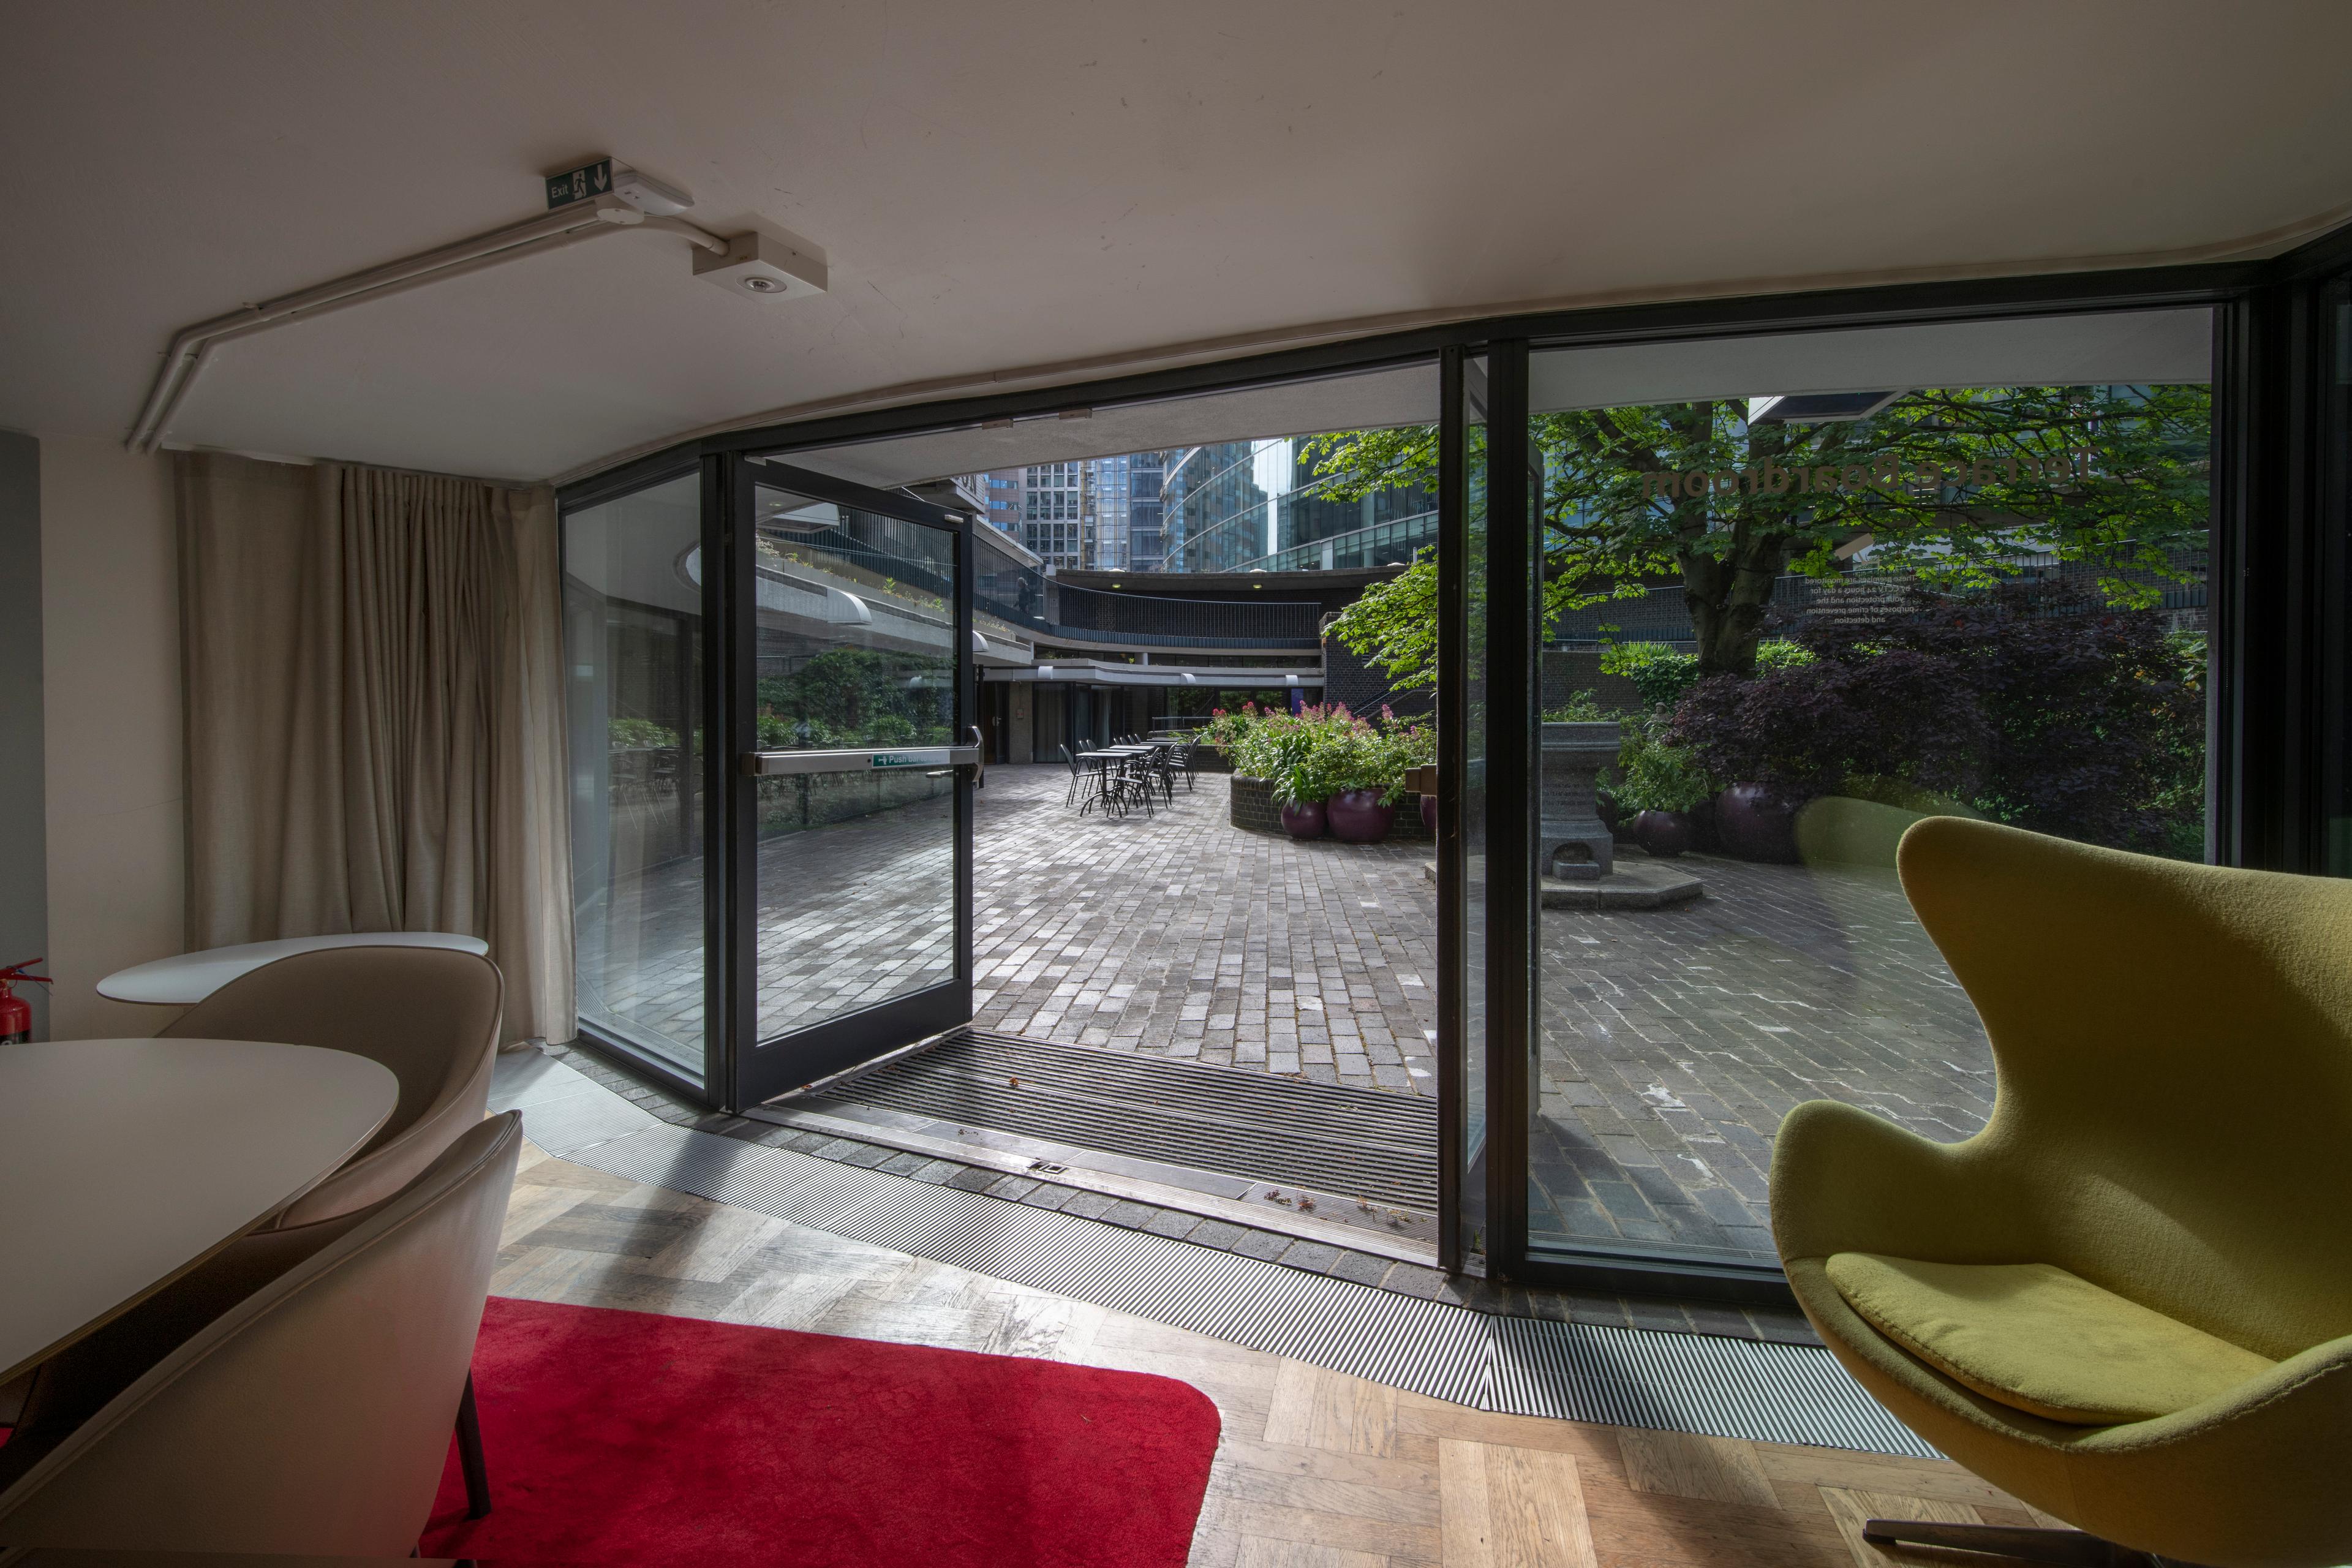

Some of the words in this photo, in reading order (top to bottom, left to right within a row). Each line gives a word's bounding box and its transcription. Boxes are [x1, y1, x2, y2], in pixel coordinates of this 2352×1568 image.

[552, 184, 568, 198] Exit
[889, 755, 907, 764] Push
[908, 754, 919, 763] bar
